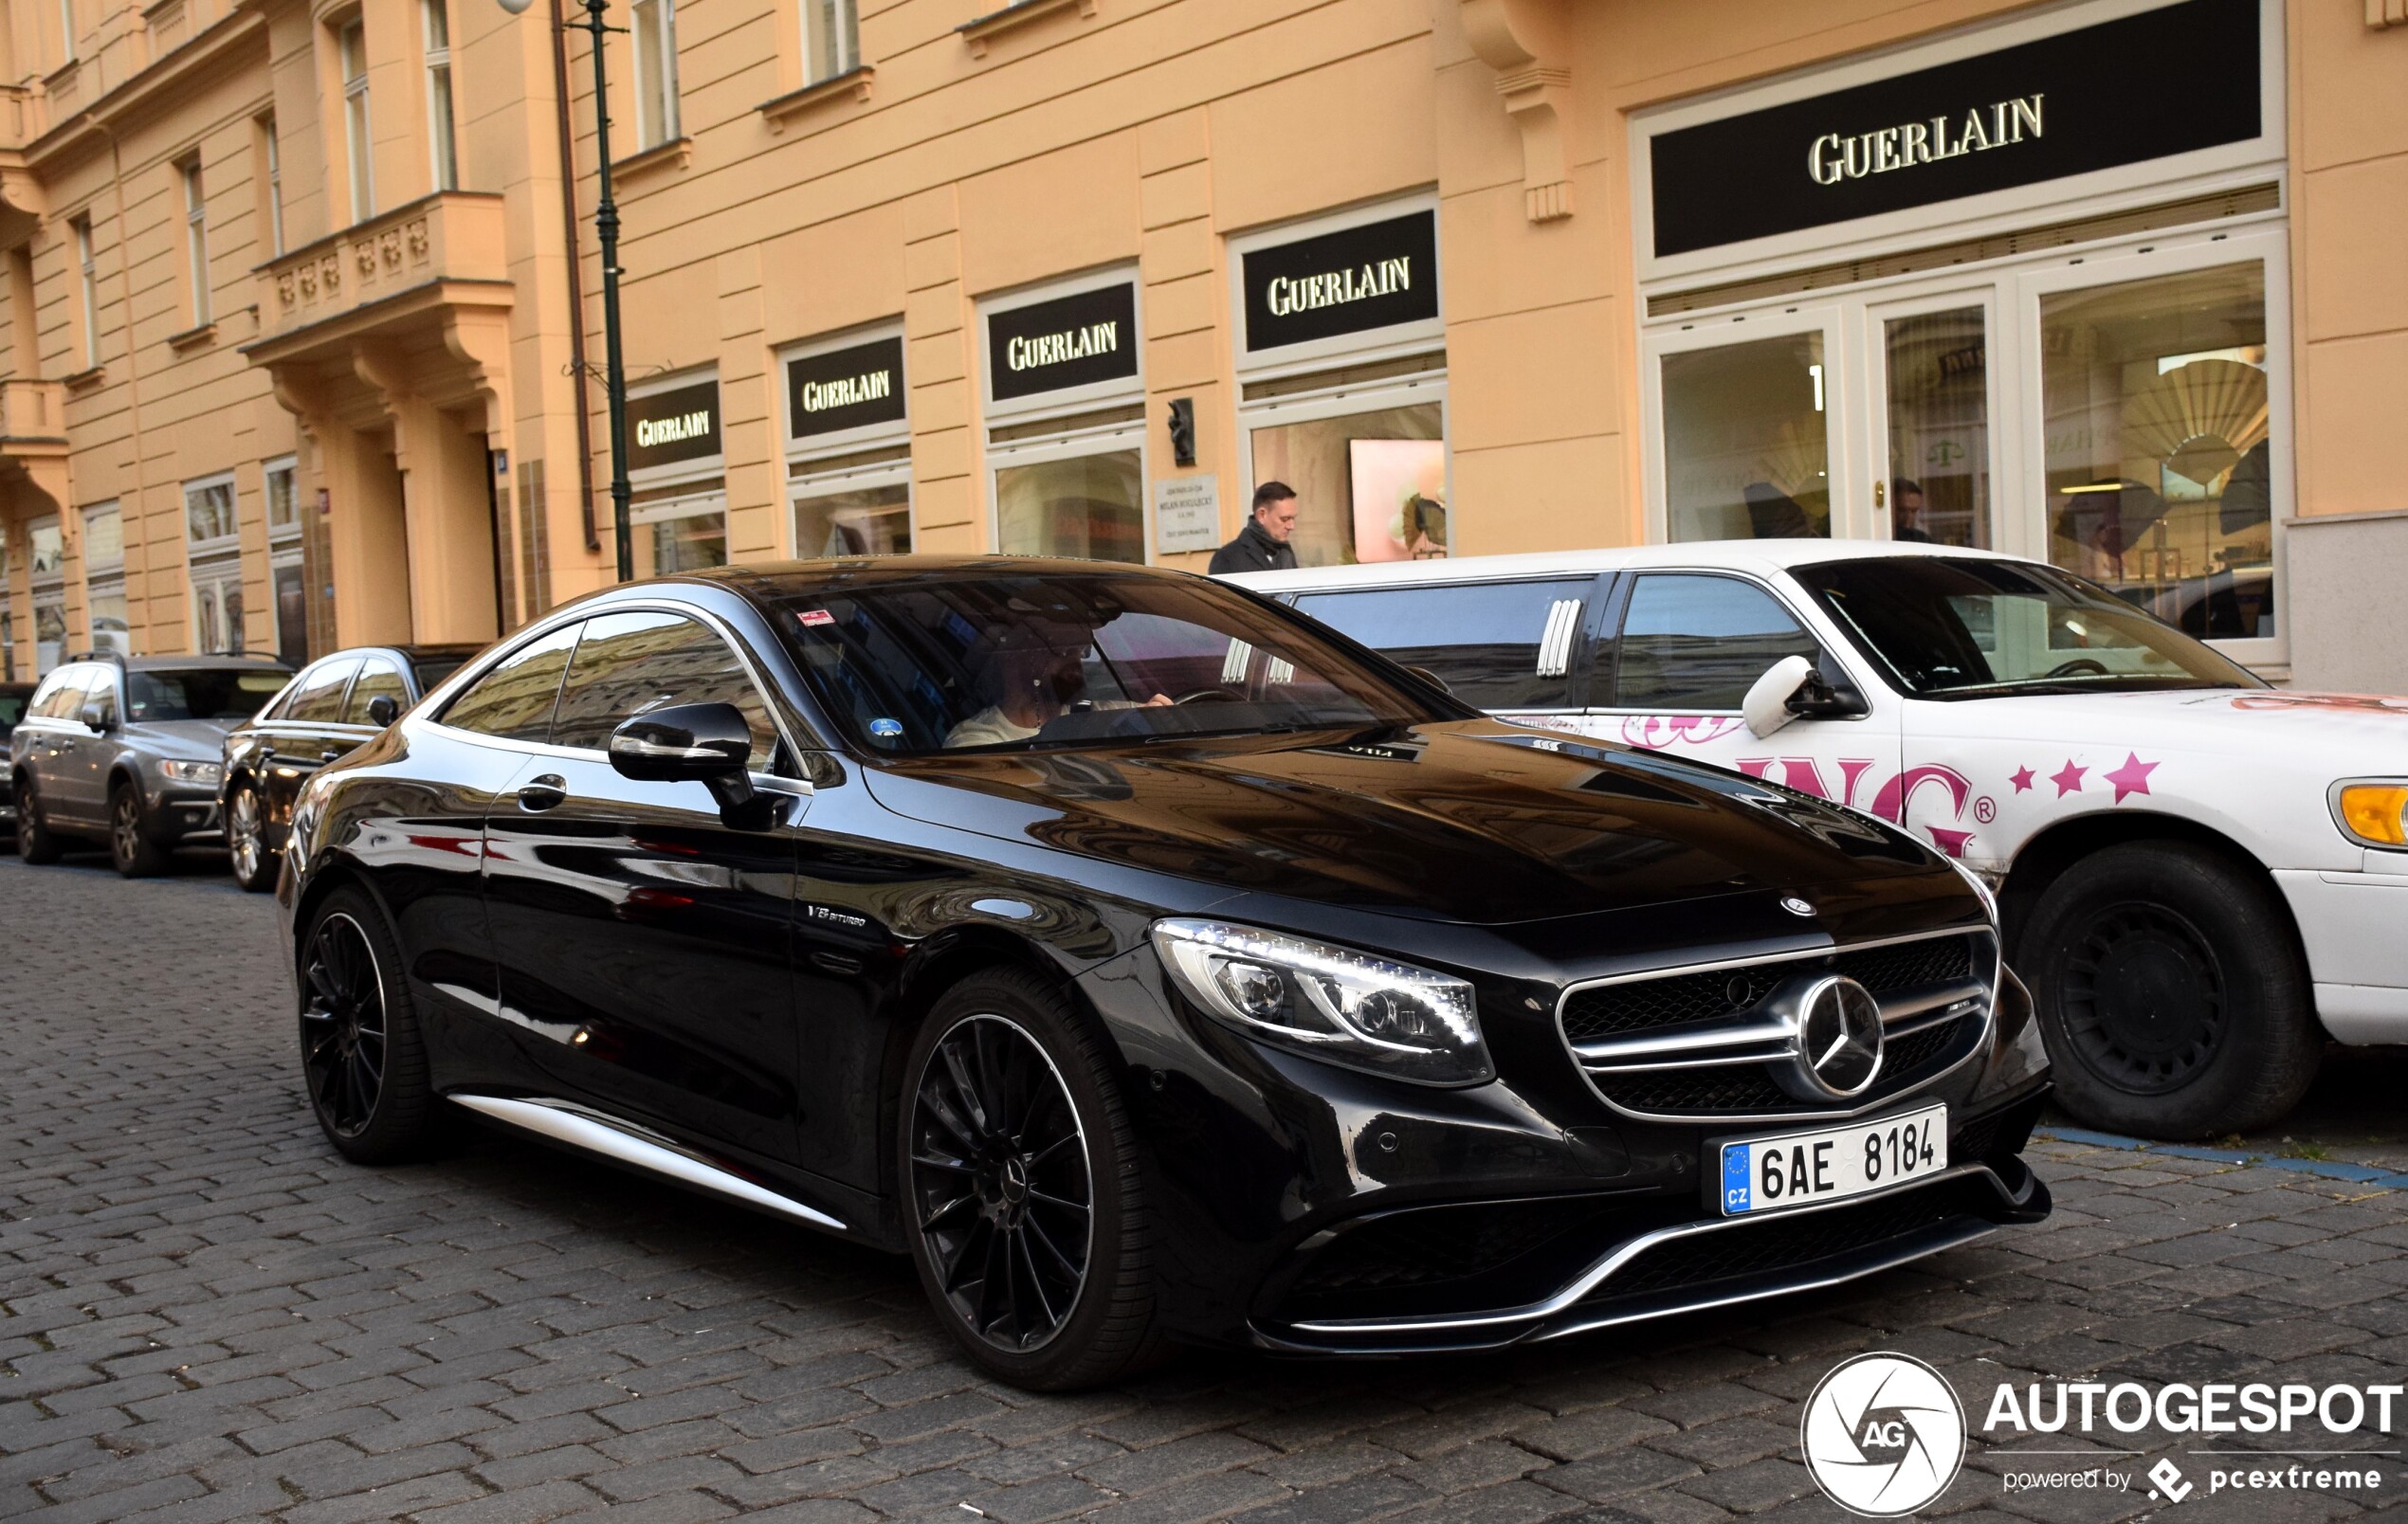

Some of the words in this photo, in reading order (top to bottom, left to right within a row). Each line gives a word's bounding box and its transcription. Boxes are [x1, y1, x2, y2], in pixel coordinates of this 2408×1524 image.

[1808, 93, 2044, 185] GUERLAIN
[1268, 257, 1410, 316] GUERLAIN
[1008, 321, 1117, 371] GUERLAIN
[804, 370, 890, 412] GUERLAIN
[637, 410, 709, 447] GUERLAIN
[830, 913, 867, 926] BITURBO
[1761, 1141, 1834, 1199] 6AE
[1865, 1117, 1933, 1181] 8184
[1728, 1188, 1747, 1205] CZ
